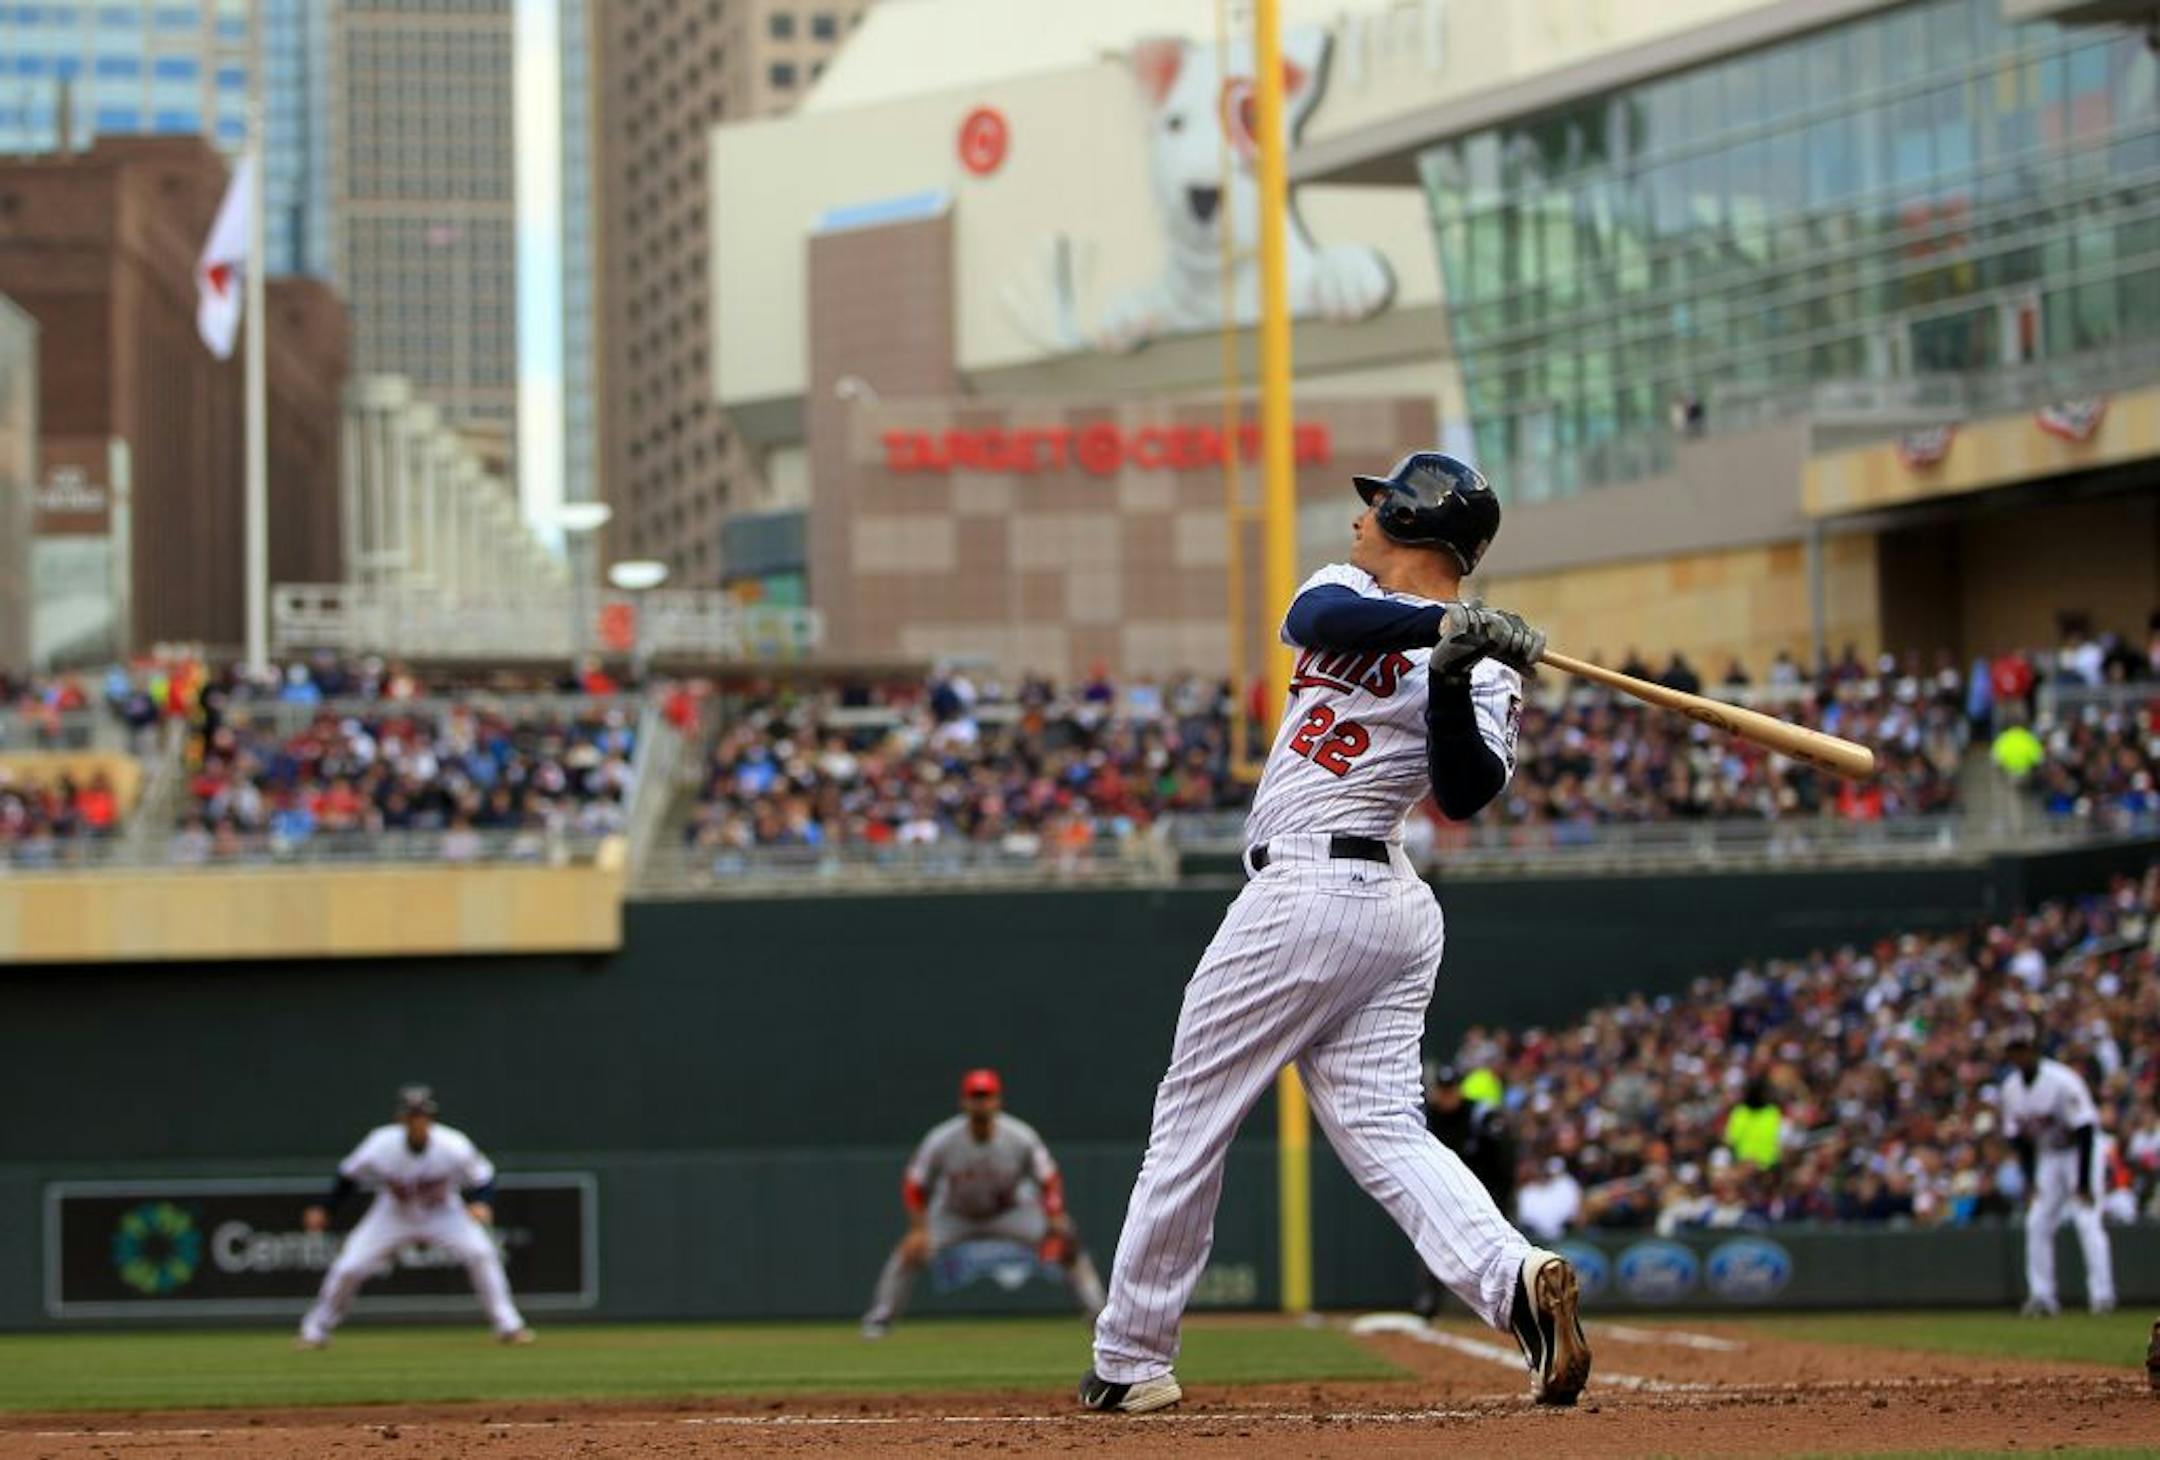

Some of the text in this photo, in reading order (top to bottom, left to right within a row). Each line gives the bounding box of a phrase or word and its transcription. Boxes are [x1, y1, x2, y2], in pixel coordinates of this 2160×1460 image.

[882, 422, 1331, 473] TARGET CENTR
[1289, 704, 1371, 777] 22
